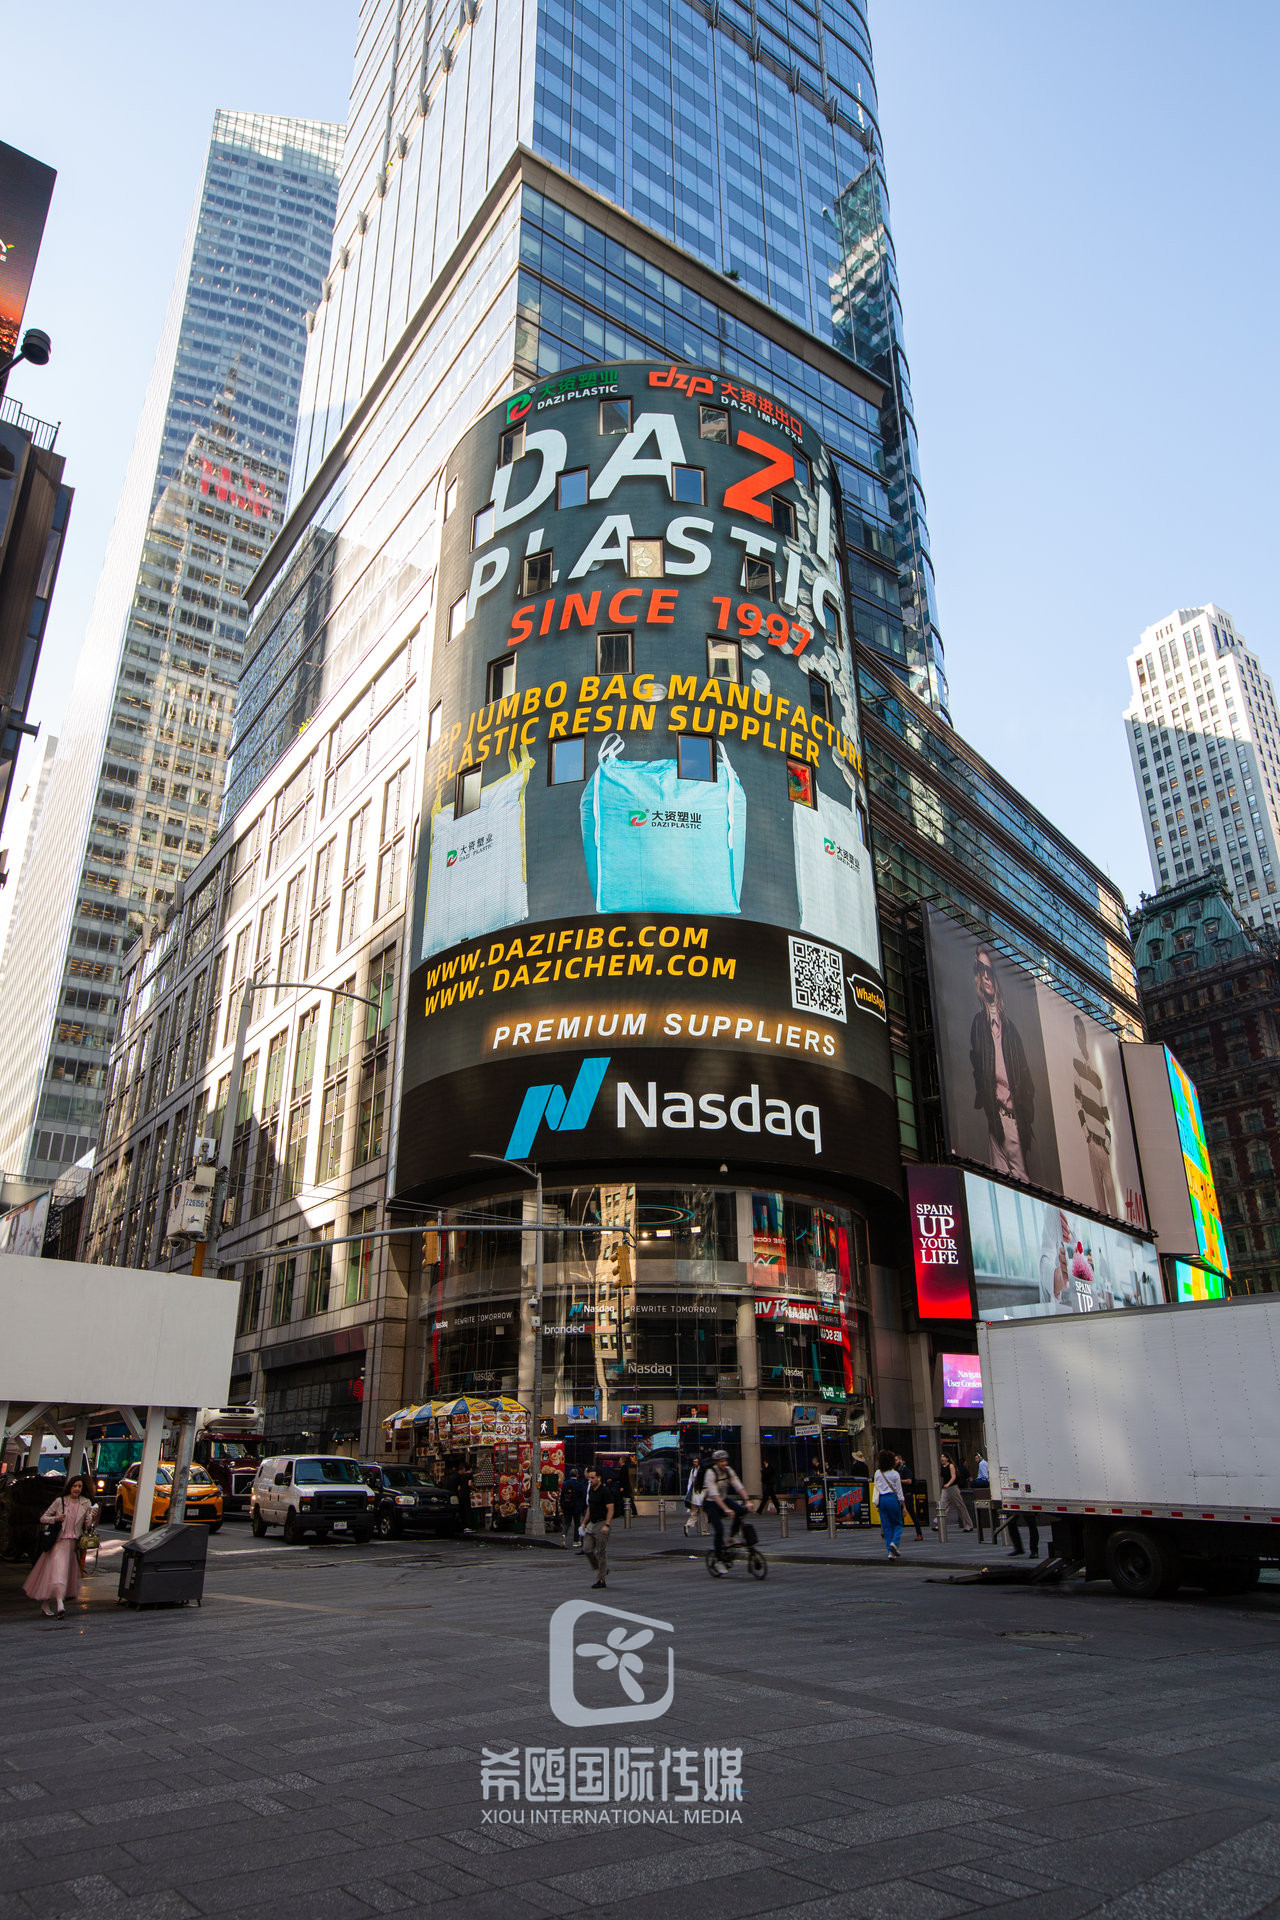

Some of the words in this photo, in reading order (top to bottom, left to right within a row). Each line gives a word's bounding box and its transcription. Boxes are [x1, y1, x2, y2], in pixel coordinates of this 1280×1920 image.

[537, 369, 619, 398] 大资塑业
[649, 366, 714, 398] dzp
[537, 393, 565, 411] DAZI
[567, 385, 619, 401] PLASTIC
[721, 382, 802, 437] 大资进出口
[721, 396, 752, 414] DAZI
[757, 409, 804, 445] IMP/EXP
[490, 412, 831, 566] DAZI
[507, 588, 679, 647] SINCE
[712, 596, 811, 656] 1997
[466, 681, 567, 746] JUMBO
[578, 673, 656, 703] BAG
[668, 674, 863, 779] MANUFACTURE
[435, 717, 540, 791] PLASTIC
[548, 704, 657, 739] RESIN
[668, 704, 820, 768] SUPPLIER
[651, 810, 702, 824] 大资塑业
[671, 822, 702, 830] PLASTIC
[426, 926, 709, 991] WWW.DAZIFIBC.COM
[492, 1013, 648, 1050] PREMIUM
[663, 1013, 836, 1056] SUPPLIERS
[617, 1081, 823, 1155] Nasdaq
[916, 1203, 953, 1216] SPAIN
[917, 1215, 955, 1238] UP
[919, 1237, 957, 1250] YOUR
[920, 1249, 959, 1265] LIFE
[1075, 1280, 1092, 1295] SPAIN
[583, 1304, 615, 1314] Nasdaq
[630, 1305, 667, 1313] REWRITE
[671, 1305, 718, 1314] TOMORROW
[1077, 1292, 1094, 1313] UP
[454, 1316, 475, 1326] REWRITE
[477, 1311, 513, 1323] TOMORROW
[628, 1362, 673, 1376] Nasdaq
[836, 1488, 864, 1515] AMAZE
